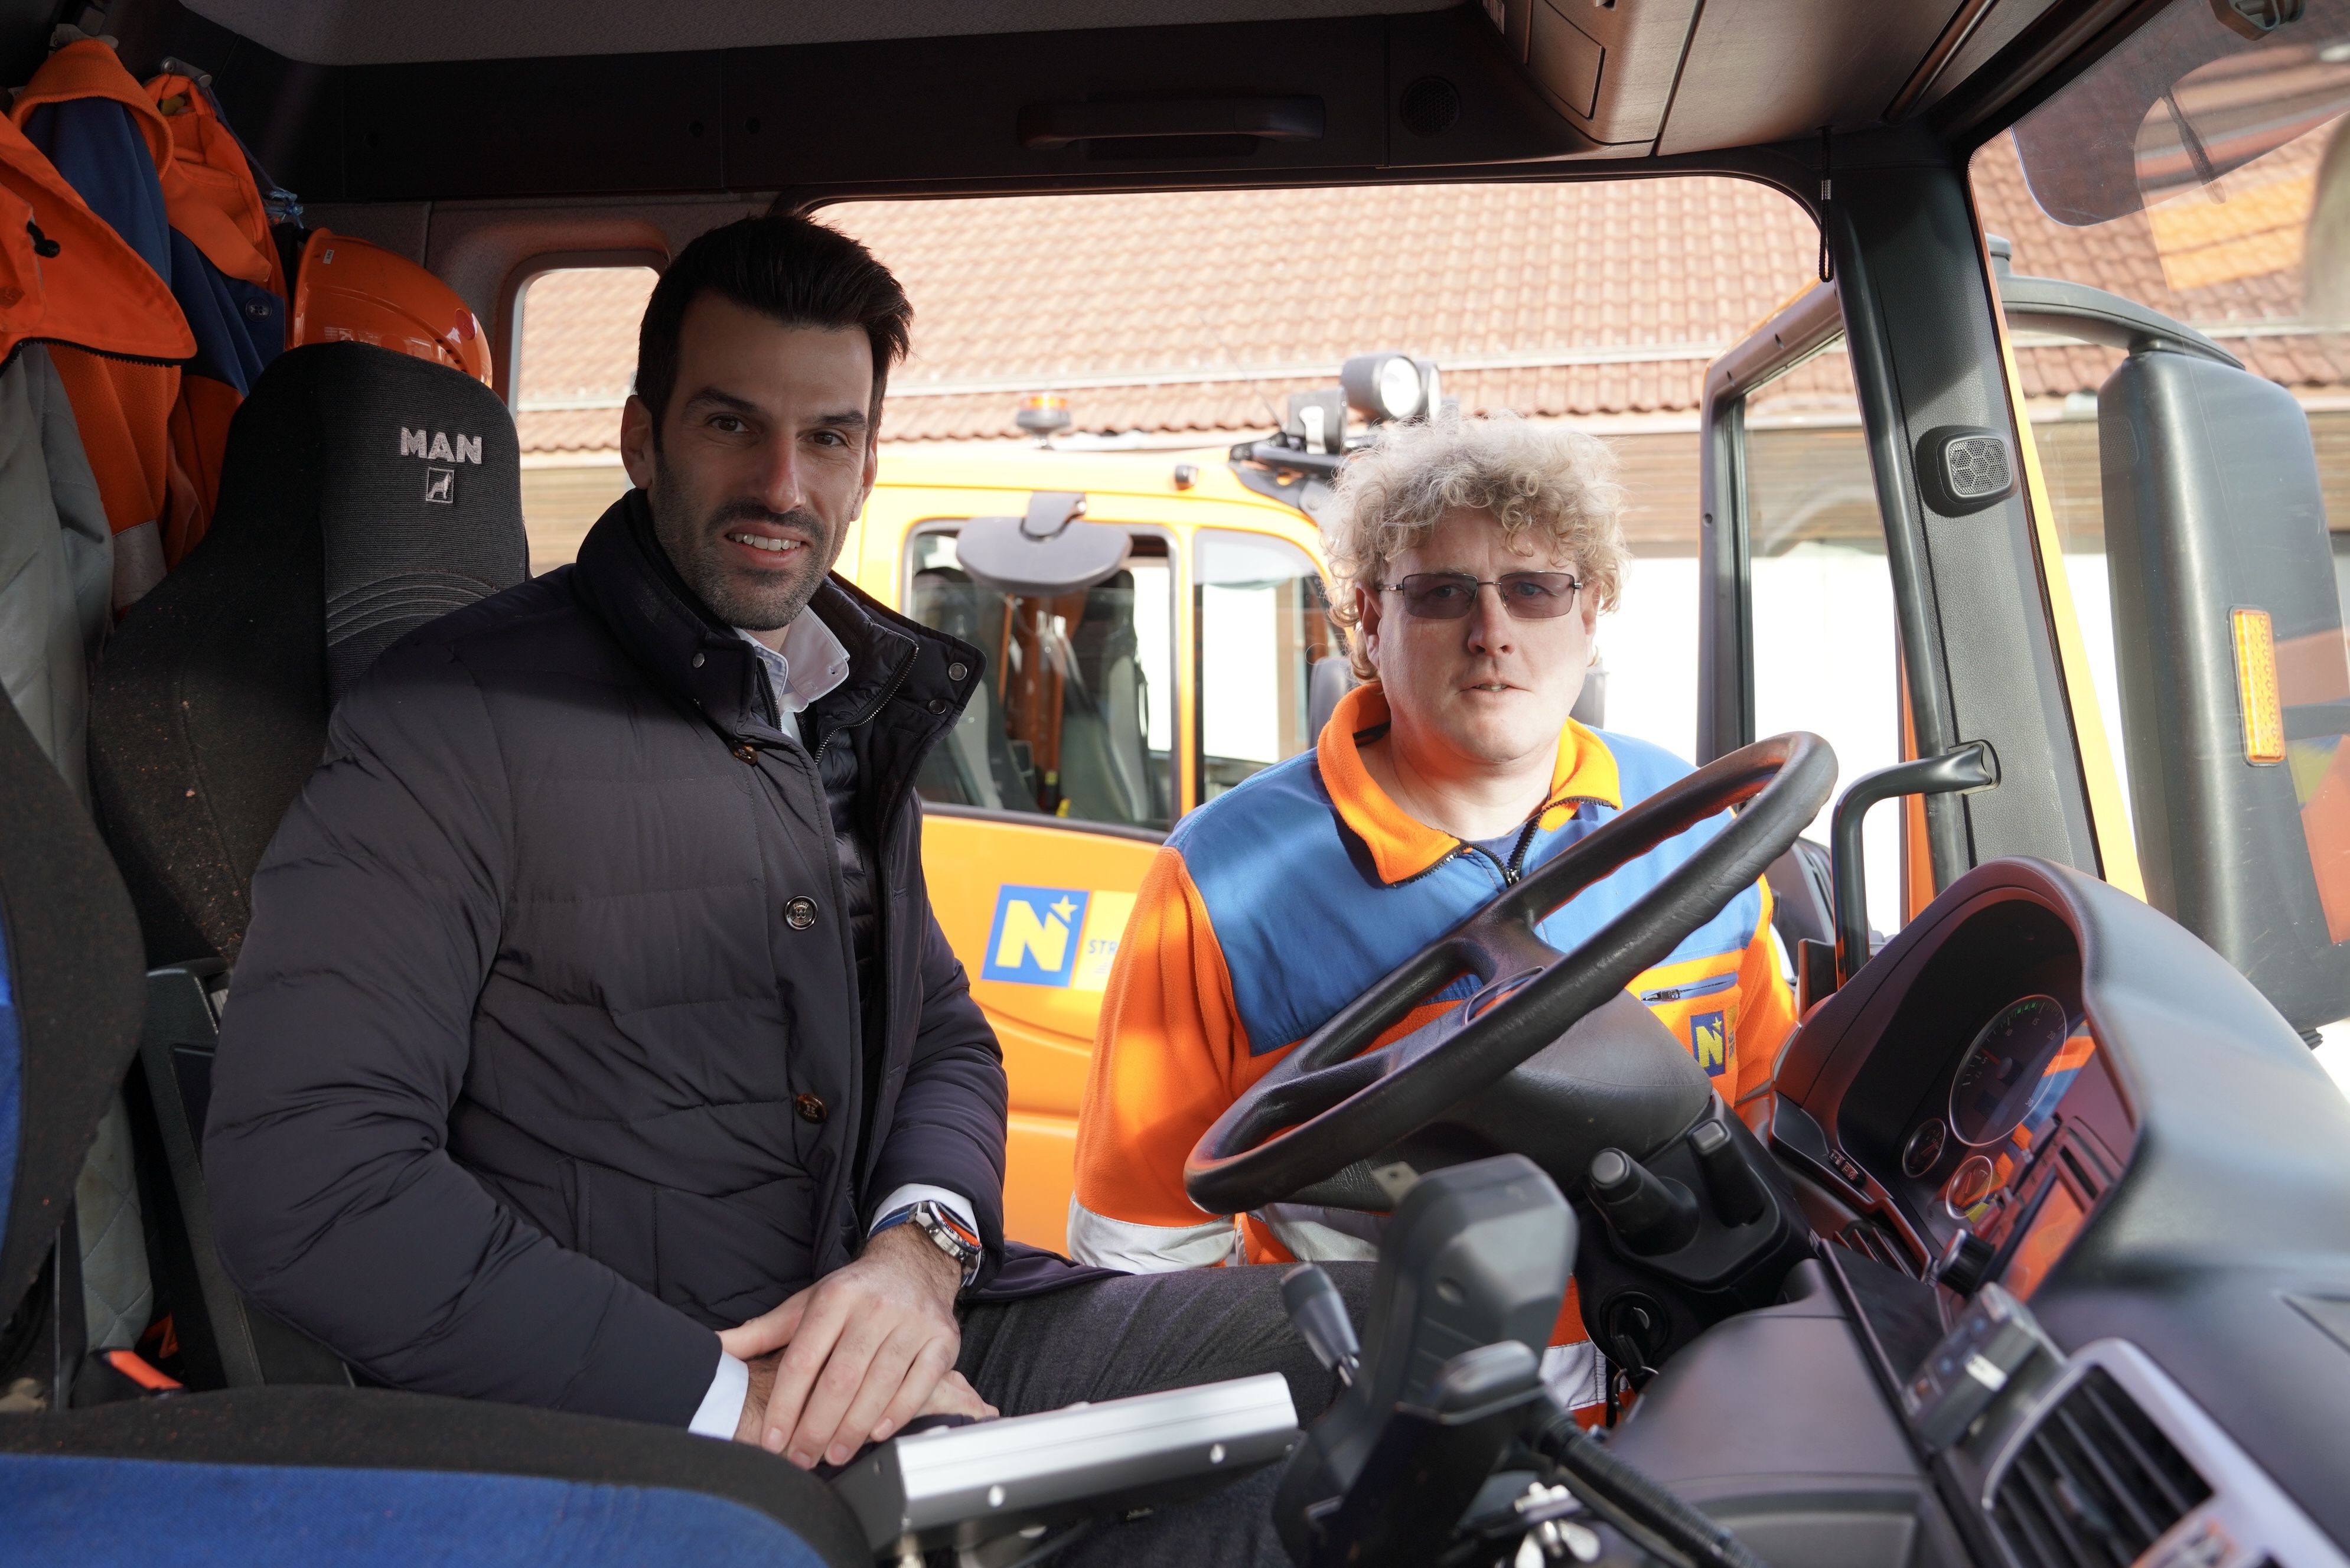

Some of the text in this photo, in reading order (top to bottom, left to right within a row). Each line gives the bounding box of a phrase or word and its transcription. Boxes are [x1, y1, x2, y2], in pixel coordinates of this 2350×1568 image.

[400, 427, 483, 464] MAN
[995, 899, 1070, 972] N
[1695, 1026, 1723, 1068] N
[2046, 1031, 2056, 1040] 20
[2025, 1097, 2033, 1107] 30
